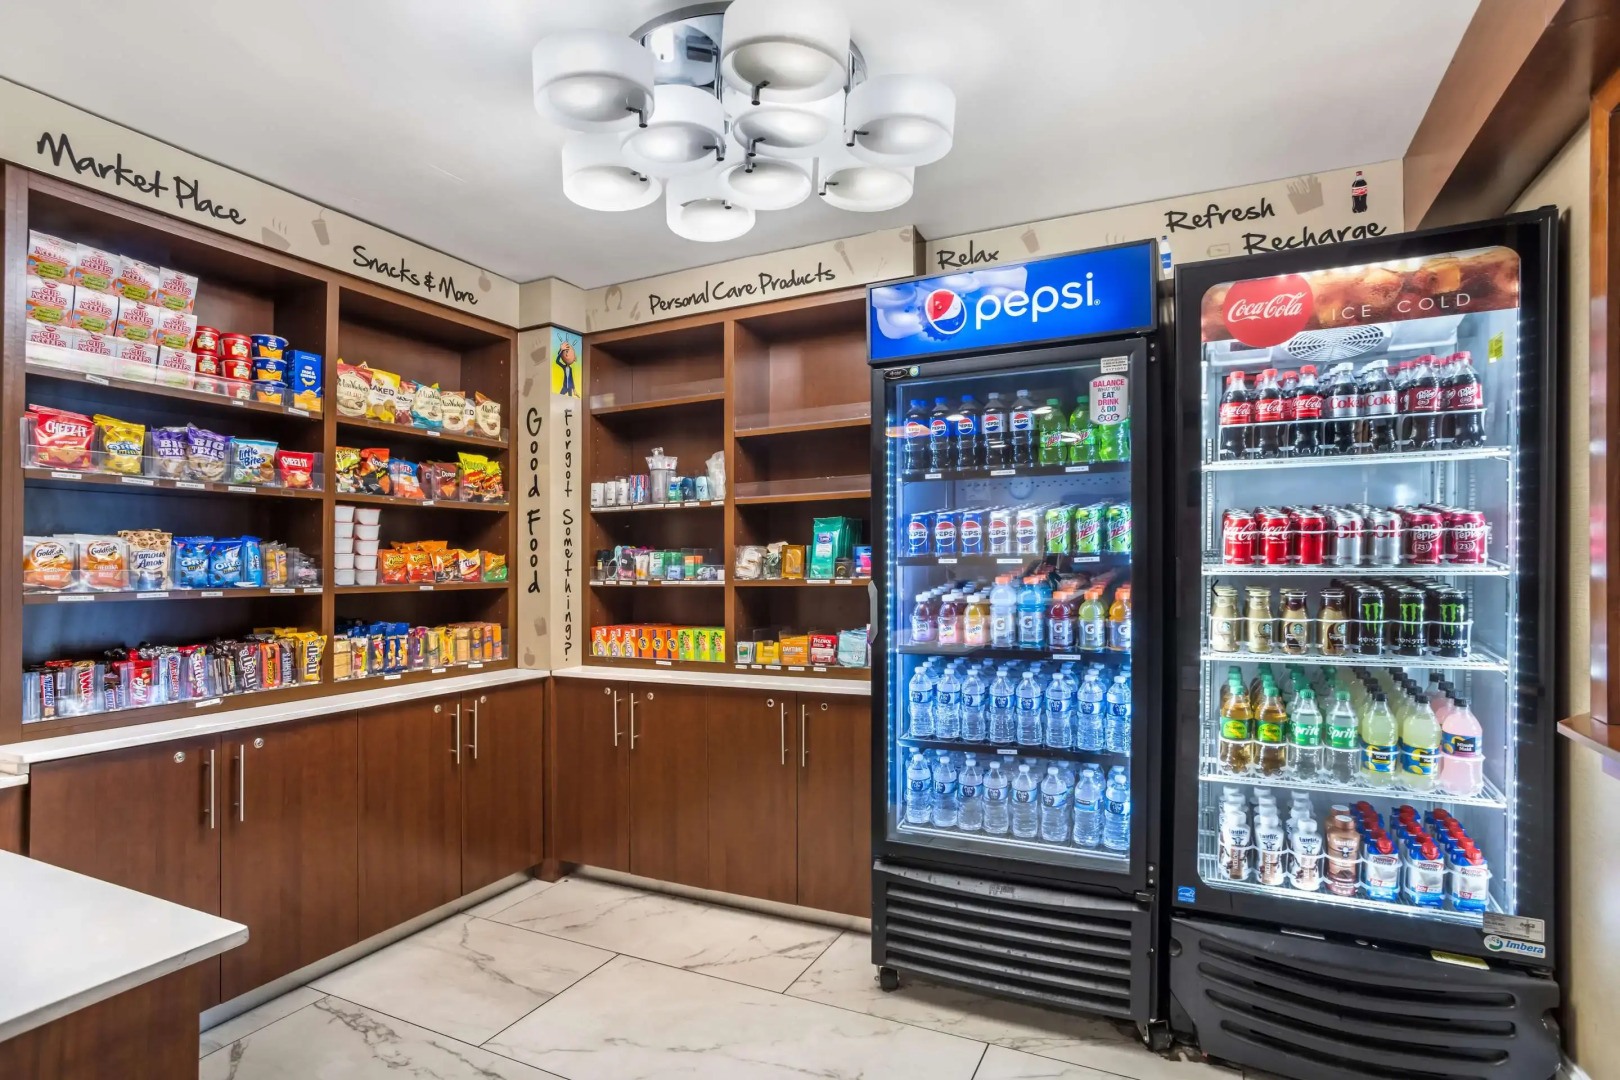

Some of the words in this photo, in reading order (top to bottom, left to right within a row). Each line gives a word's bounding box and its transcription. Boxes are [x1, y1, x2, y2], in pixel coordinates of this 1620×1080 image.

[36, 132, 168, 198] Market
[173, 175, 247, 226] Place
[1164, 197, 1275, 232] Refresh
[1241, 222, 1388, 255] Recharge
[936, 240, 999, 270] Relax
[352, 244, 421, 288] Snacks
[423, 272, 437, 291] &
[438, 275, 478, 305] More
[648, 280, 710, 315] Personal
[712, 280, 757, 301] Care
[758, 261, 836, 295] Products
[975, 272, 1094, 330] pepsi
[1227, 291, 1308, 323] Coca-Cola
[1331, 305, 1371, 321] ICE
[1396, 293, 1472, 314] COLD
[1093, 379, 1125, 388] BALANCE
[1097, 398, 1119, 406] DRINK
[1366, 393, 1398, 405] Coke
[194, 438, 225, 451] BIG
[192, 446, 225, 460] TEXAS
[238, 444, 259, 461] Little
[526, 407, 542, 499] Good
[564, 409, 573, 498] Forgot
[244, 456, 266, 468] Bites
[130, 550, 167, 562] Famous
[526, 509, 542, 594] Food
[137, 558, 164, 569] Amos
[562, 509, 574, 661] Something?
[995, 618, 1005, 631] G
[1022, 615, 1033, 629] G
[1053, 622, 1063, 634] G
[1085, 623, 1095, 635] G
[1117, 624, 1129, 636] G
[44, 674, 55, 706] SNICKERS
[1291, 724, 1320, 737] Sprite
[1327, 727, 1358, 740] Sprite
[1505, 940, 1545, 954] Imbera
